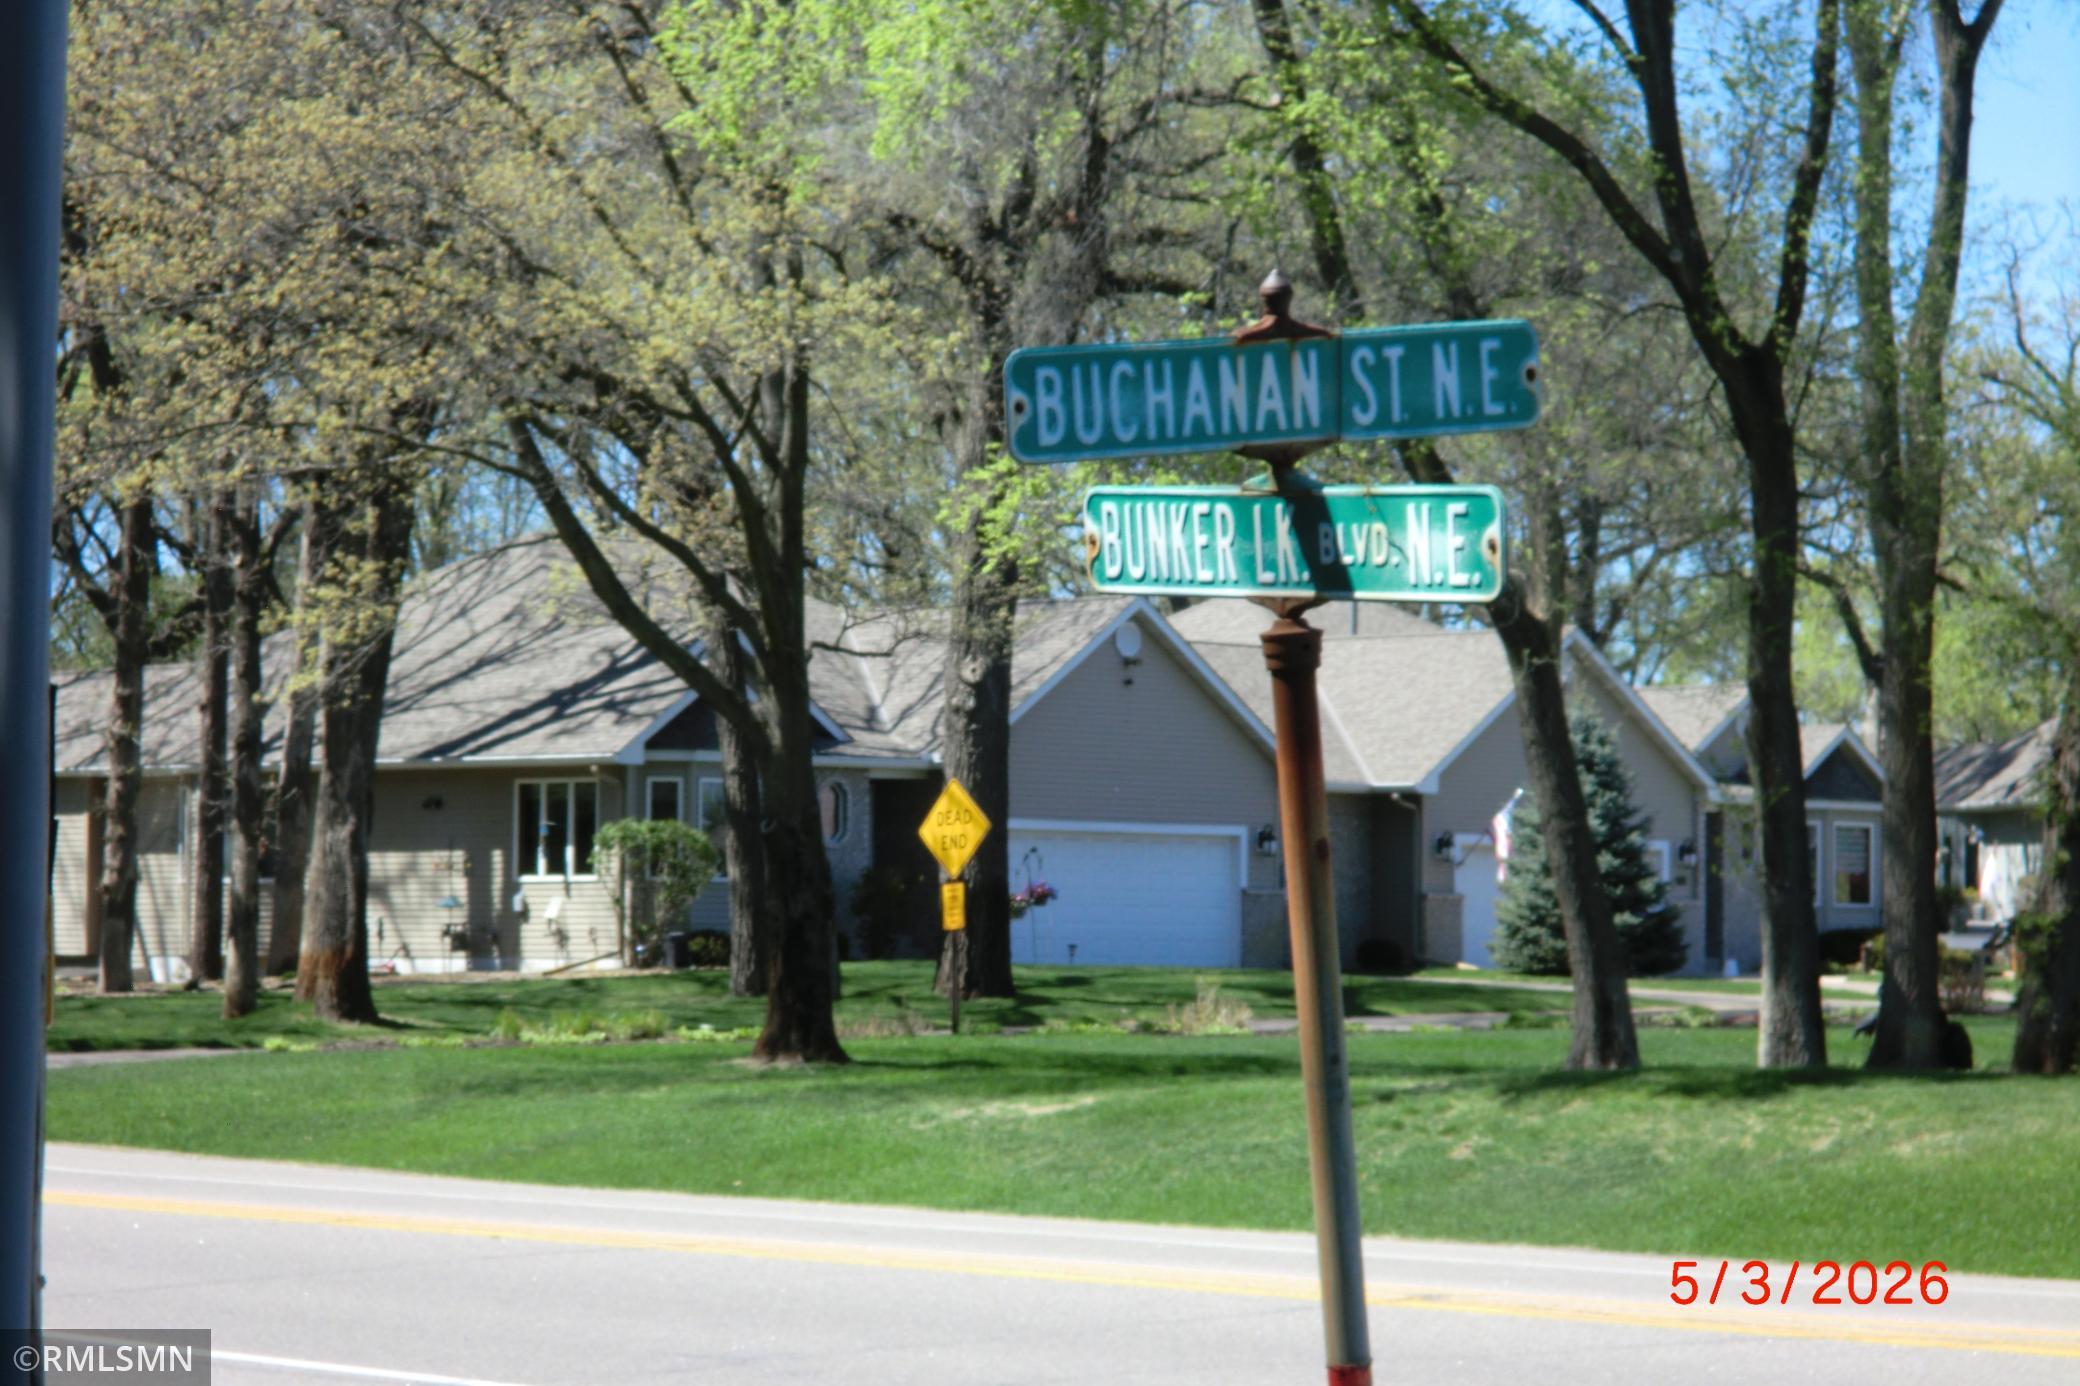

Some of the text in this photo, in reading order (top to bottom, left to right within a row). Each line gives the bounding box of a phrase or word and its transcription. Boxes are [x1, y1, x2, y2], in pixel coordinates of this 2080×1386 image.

[1034, 347, 1321, 447] BUCHANAN
[1432, 337, 1518, 420] N.E.
[1100, 500, 1483, 587] BUNKER LK. BLVD. N.E.
[936, 809, 973, 827] DEAD
[941, 833, 968, 851] END
